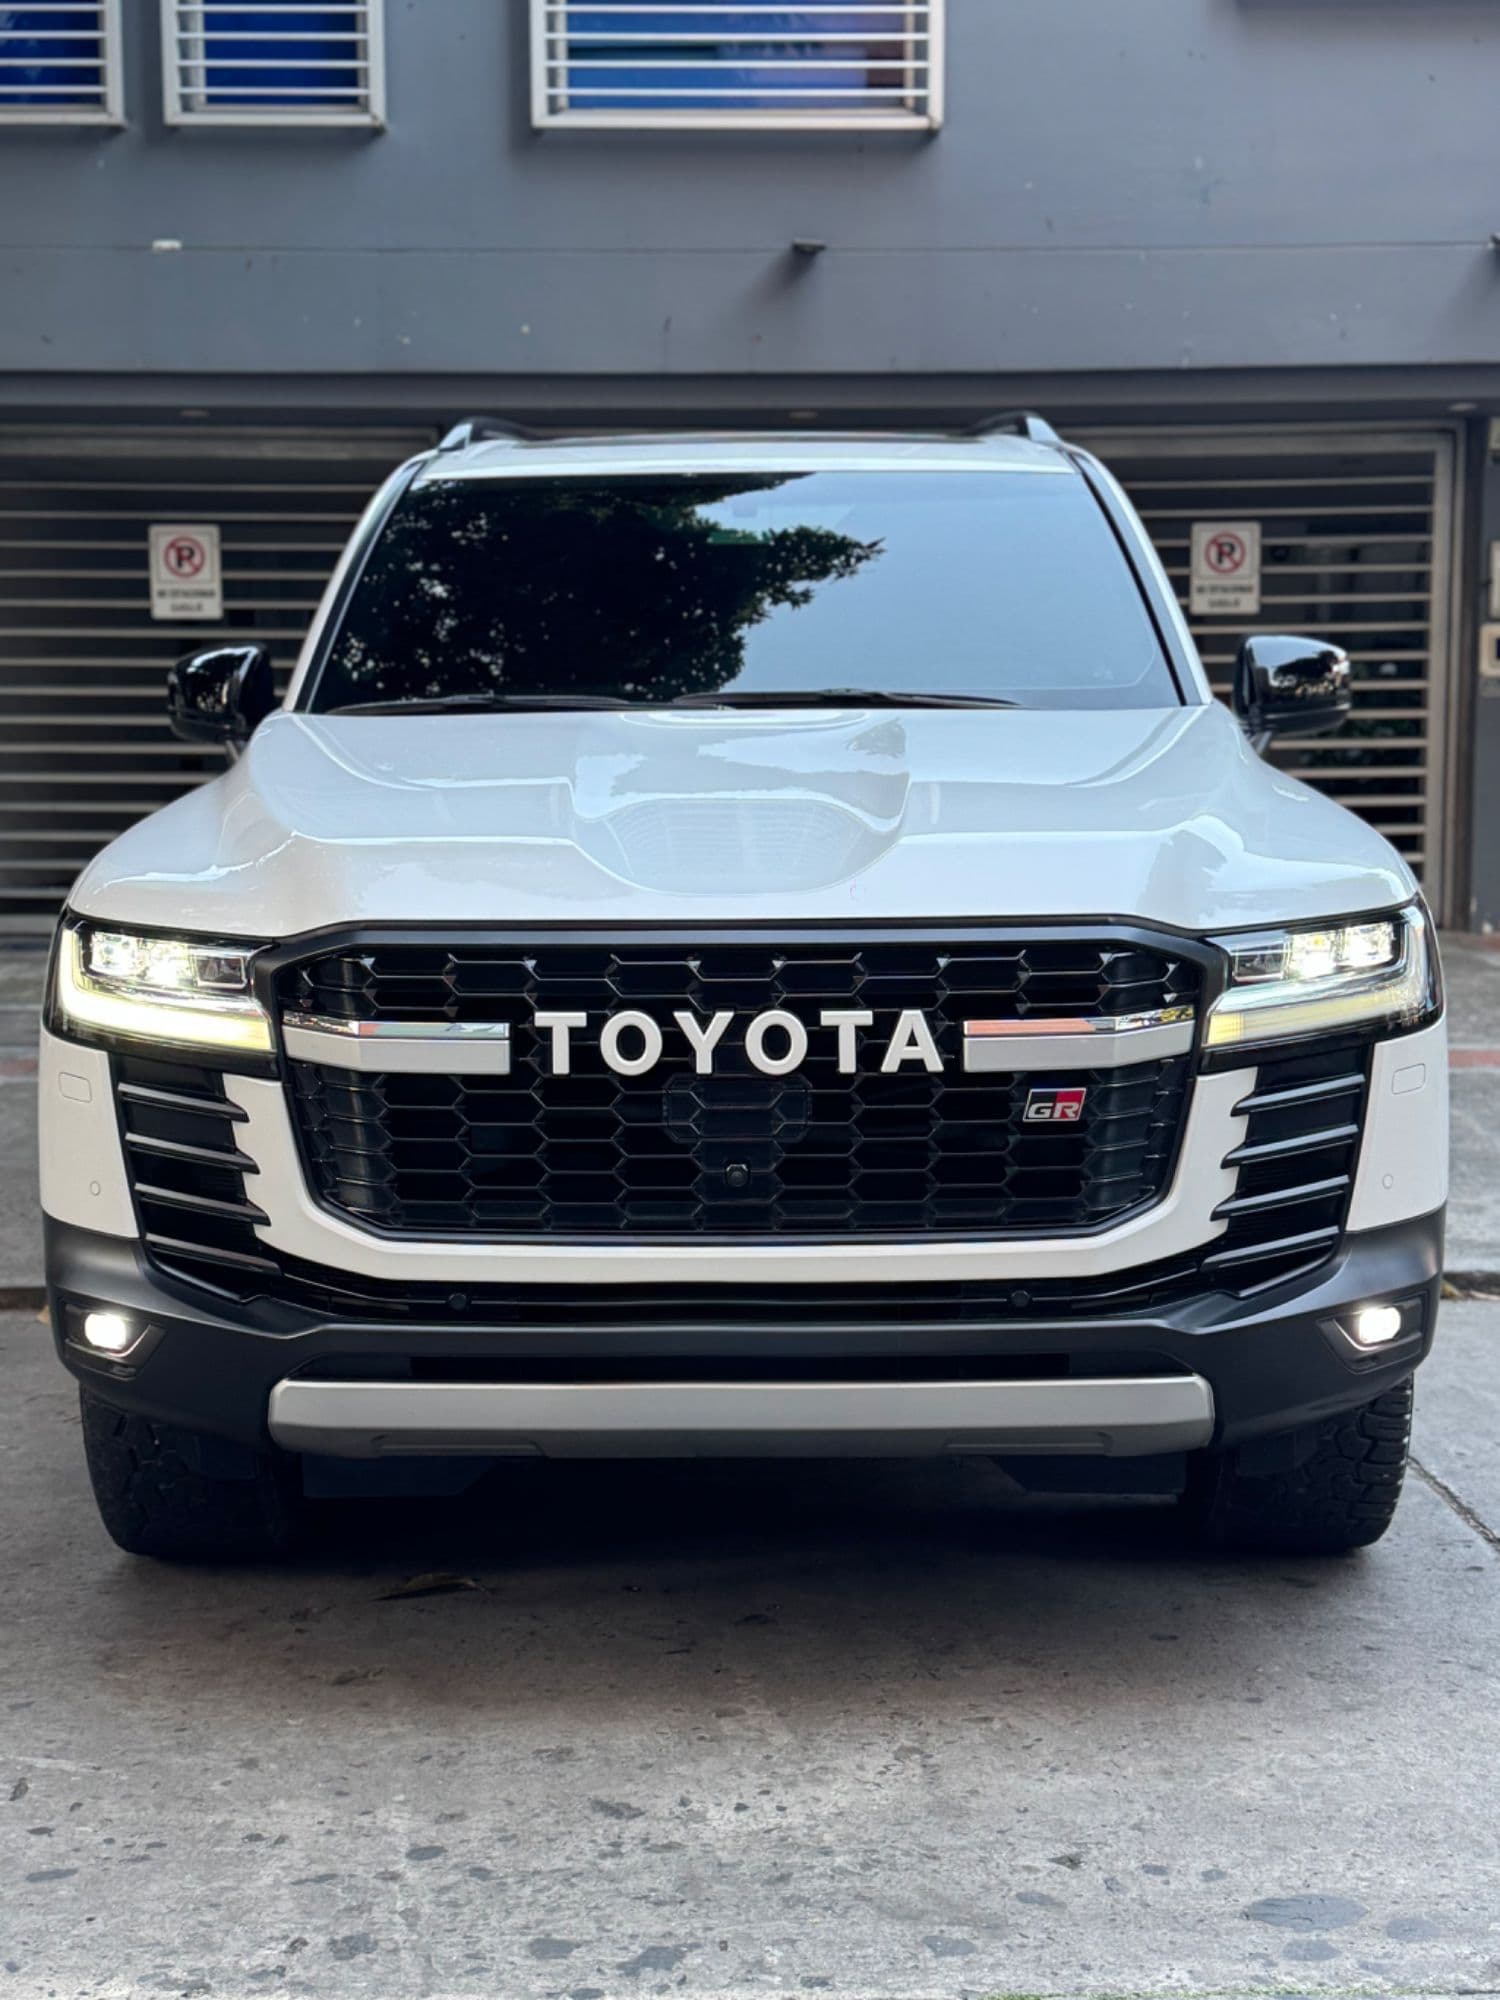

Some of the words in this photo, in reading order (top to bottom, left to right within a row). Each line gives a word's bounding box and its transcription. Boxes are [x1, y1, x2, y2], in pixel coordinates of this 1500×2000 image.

[176, 545, 195, 569] P
[1216, 541, 1235, 565] P
[533, 1009, 945, 1076] TOYOTA
[1027, 1102, 1080, 1119] GR
